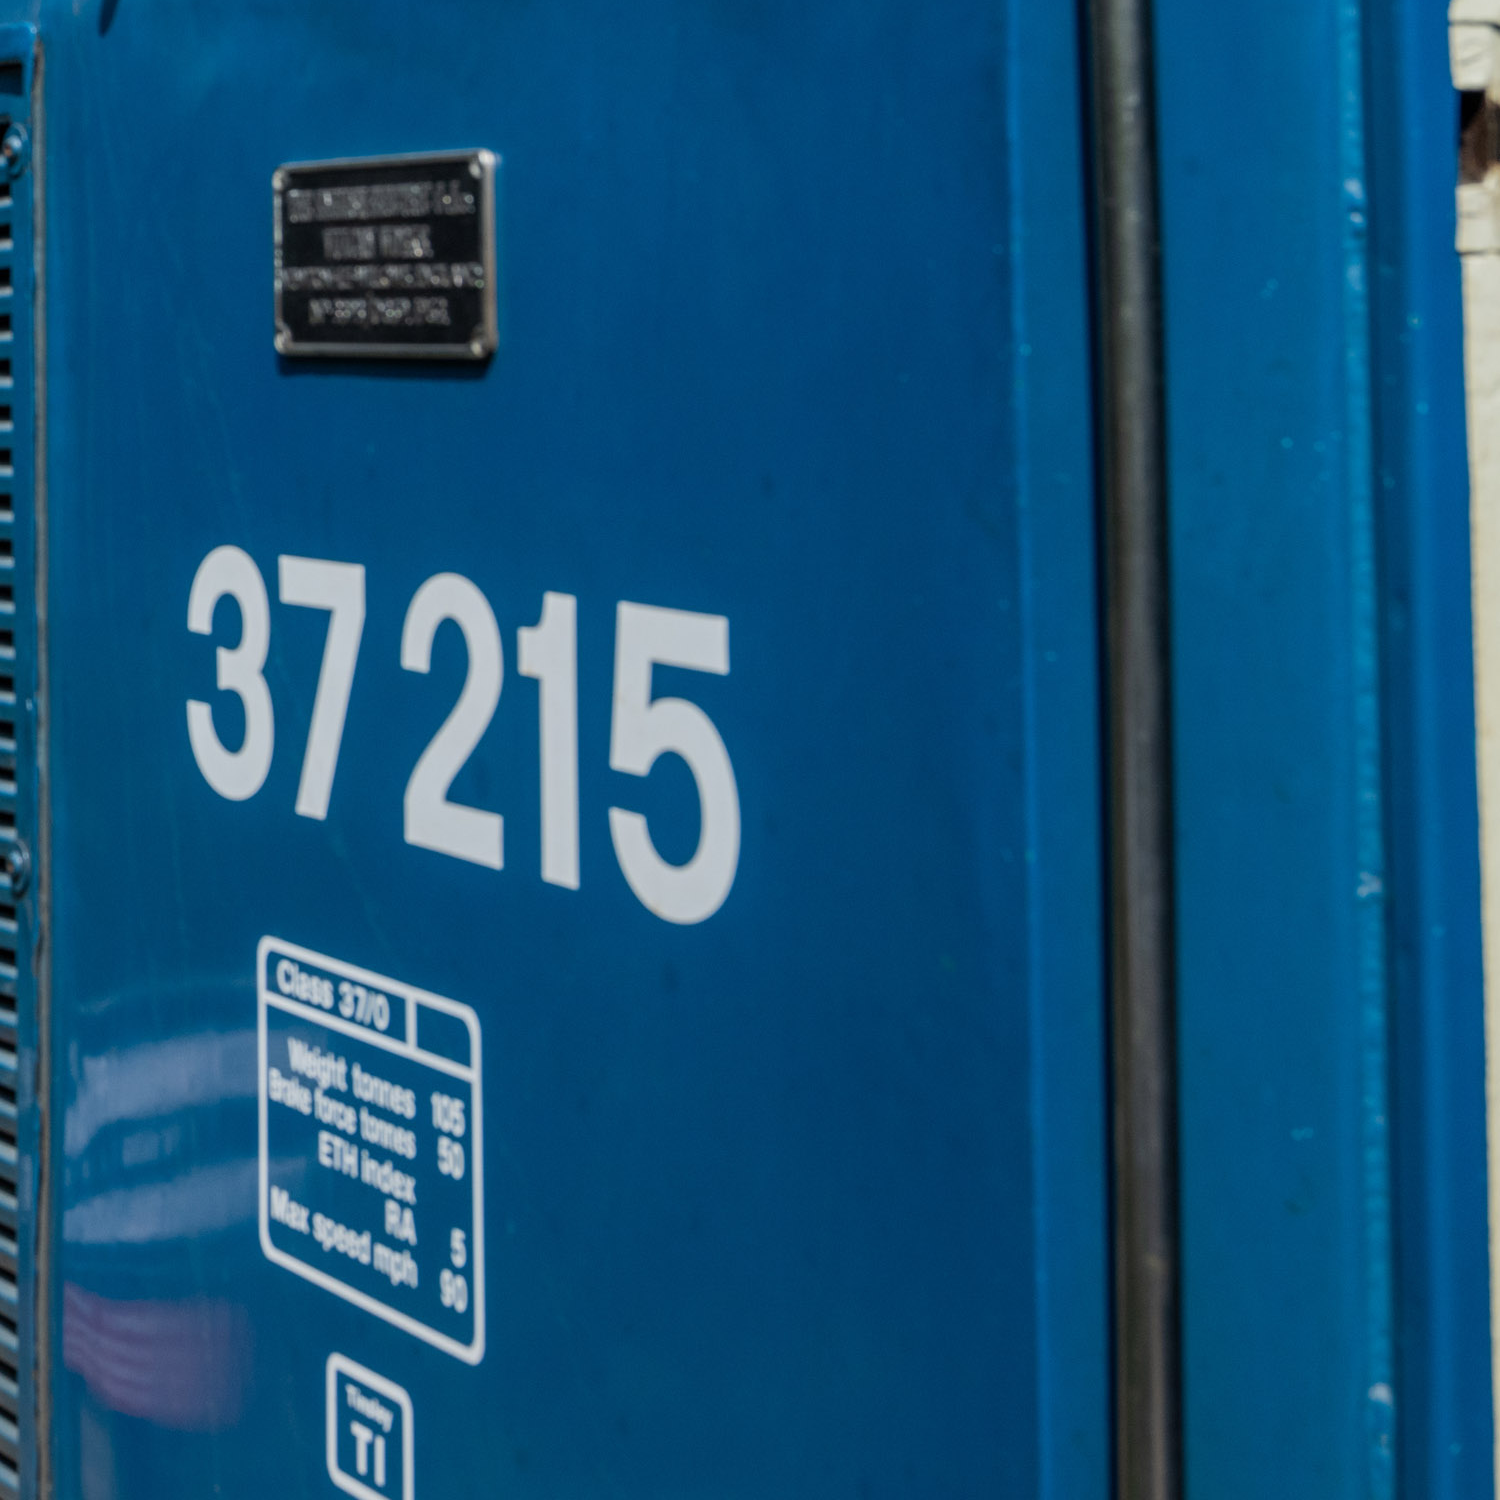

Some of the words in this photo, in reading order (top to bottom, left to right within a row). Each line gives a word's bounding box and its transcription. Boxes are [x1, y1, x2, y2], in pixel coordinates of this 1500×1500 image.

[186, 544, 366, 821] 37
[400, 571, 742, 925] 215
[276, 959, 334, 1010] Class
[338, 980, 390, 1032] 37/0
[269, 1067, 312, 1116] Brake
[314, 1087, 357, 1135] force
[359, 1106, 417, 1160] tonnes
[437, 1134, 465, 1181] 50
[287, 1036, 348, 1092] Weight
[352, 1062, 416, 1119] tonnes
[430, 1091, 465, 1138] 105
[318, 1129, 359, 1179] ETH
[360, 1149, 417, 1206] index
[270, 1185, 310, 1235] Max
[312, 1211, 371, 1266] speed
[373, 1241, 418, 1289] mph
[439, 1267, 469, 1314] 90
[384, 1198, 417, 1247] RA
[450, 1227, 467, 1269] 5
[350, 1420, 386, 1488] TI
